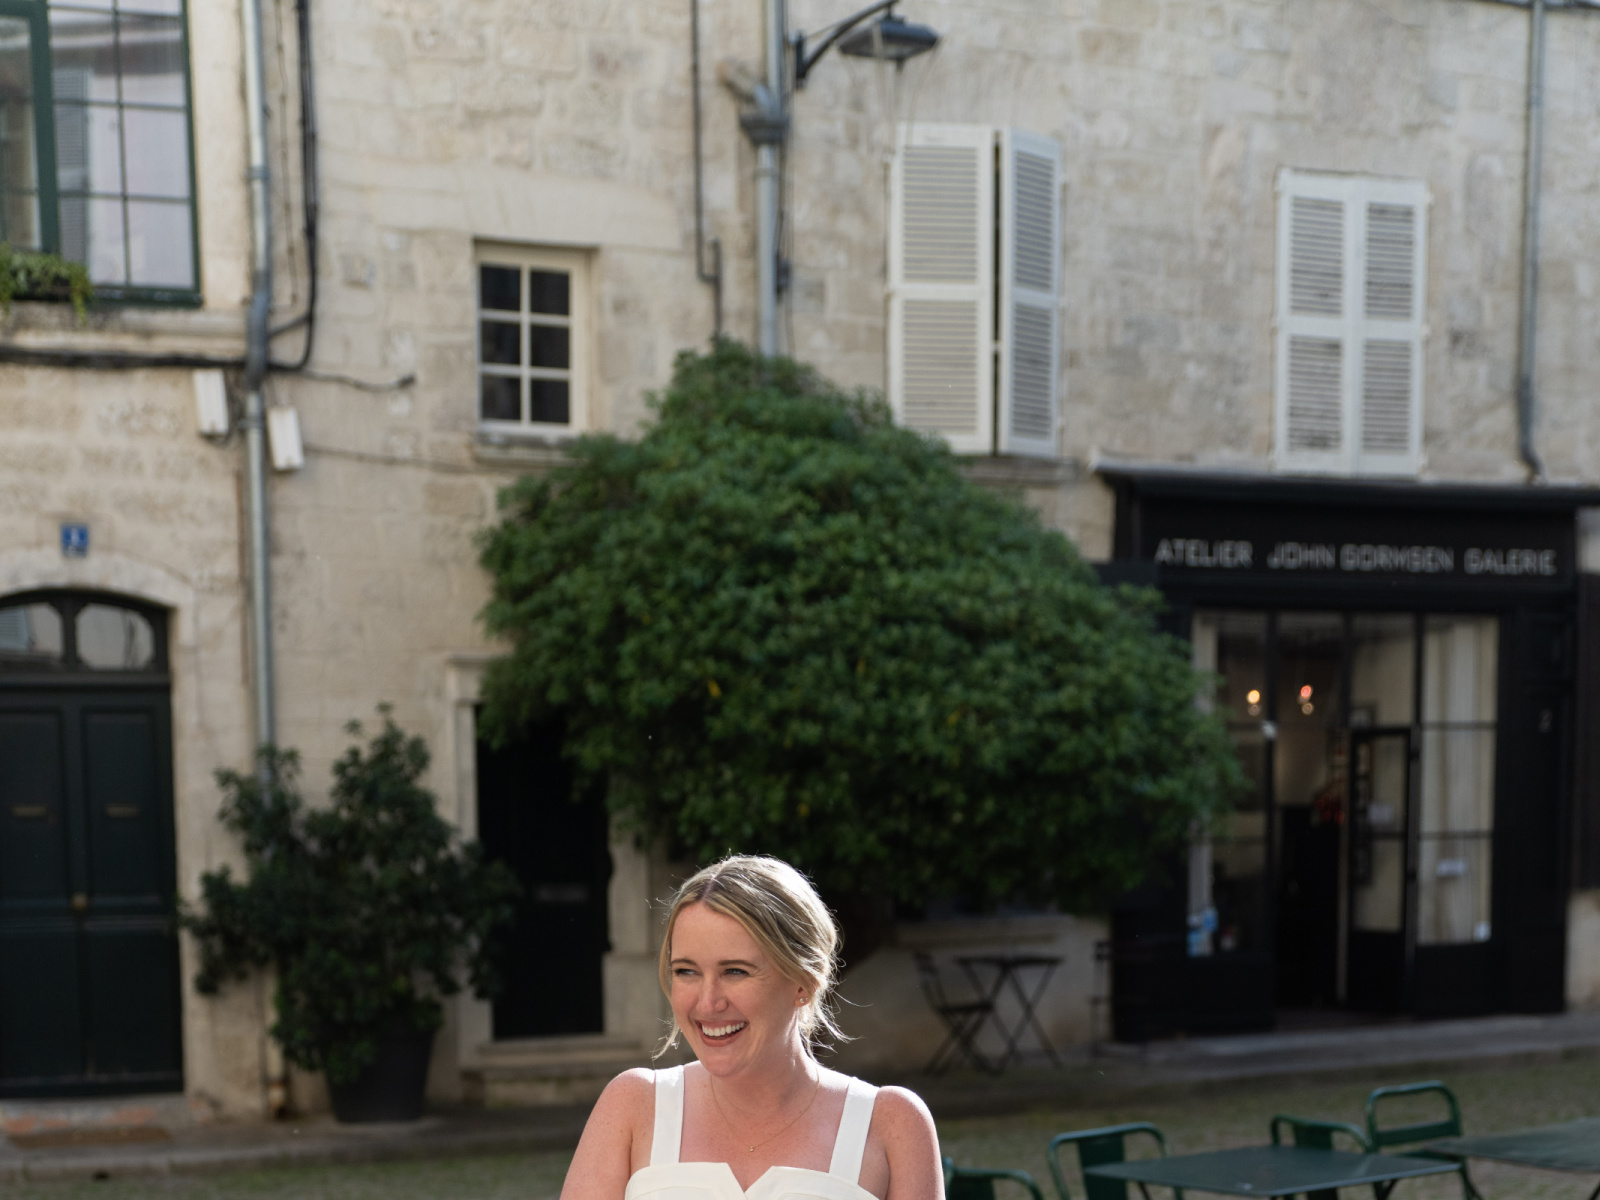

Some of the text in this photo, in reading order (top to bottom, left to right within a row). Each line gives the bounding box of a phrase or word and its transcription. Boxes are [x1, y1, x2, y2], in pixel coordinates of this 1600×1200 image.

[1155, 539, 1557, 575] ATELIER JOHN GORMSEN GALERIE
